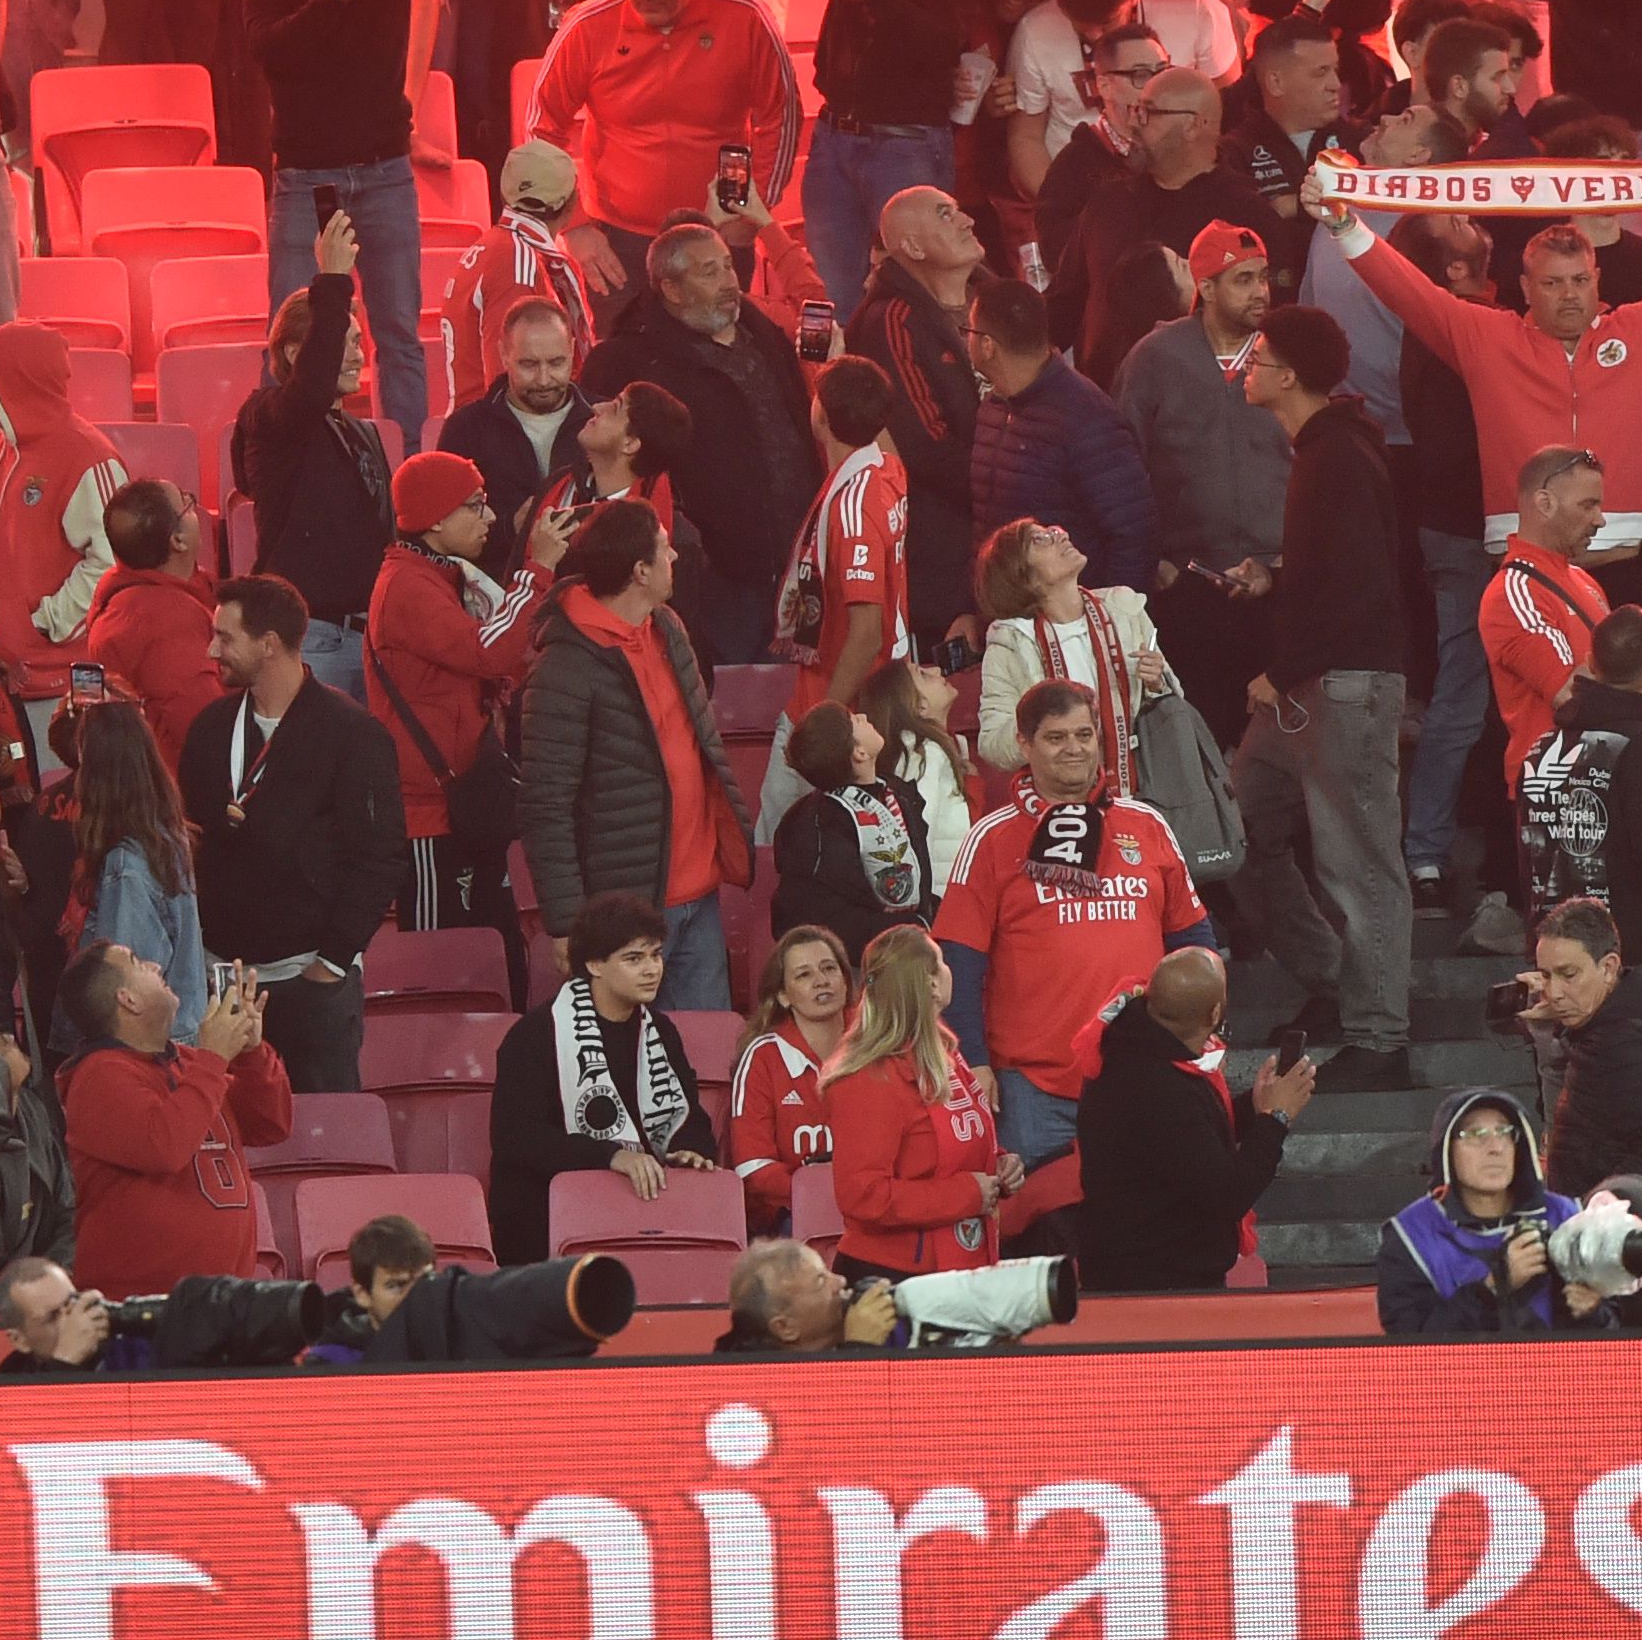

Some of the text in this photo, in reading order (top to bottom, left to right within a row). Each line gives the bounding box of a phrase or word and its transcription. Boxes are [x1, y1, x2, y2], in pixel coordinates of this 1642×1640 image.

[1333, 171, 1492, 203] DIABOS
[1058, 899, 1137, 925] FLY BETTER
